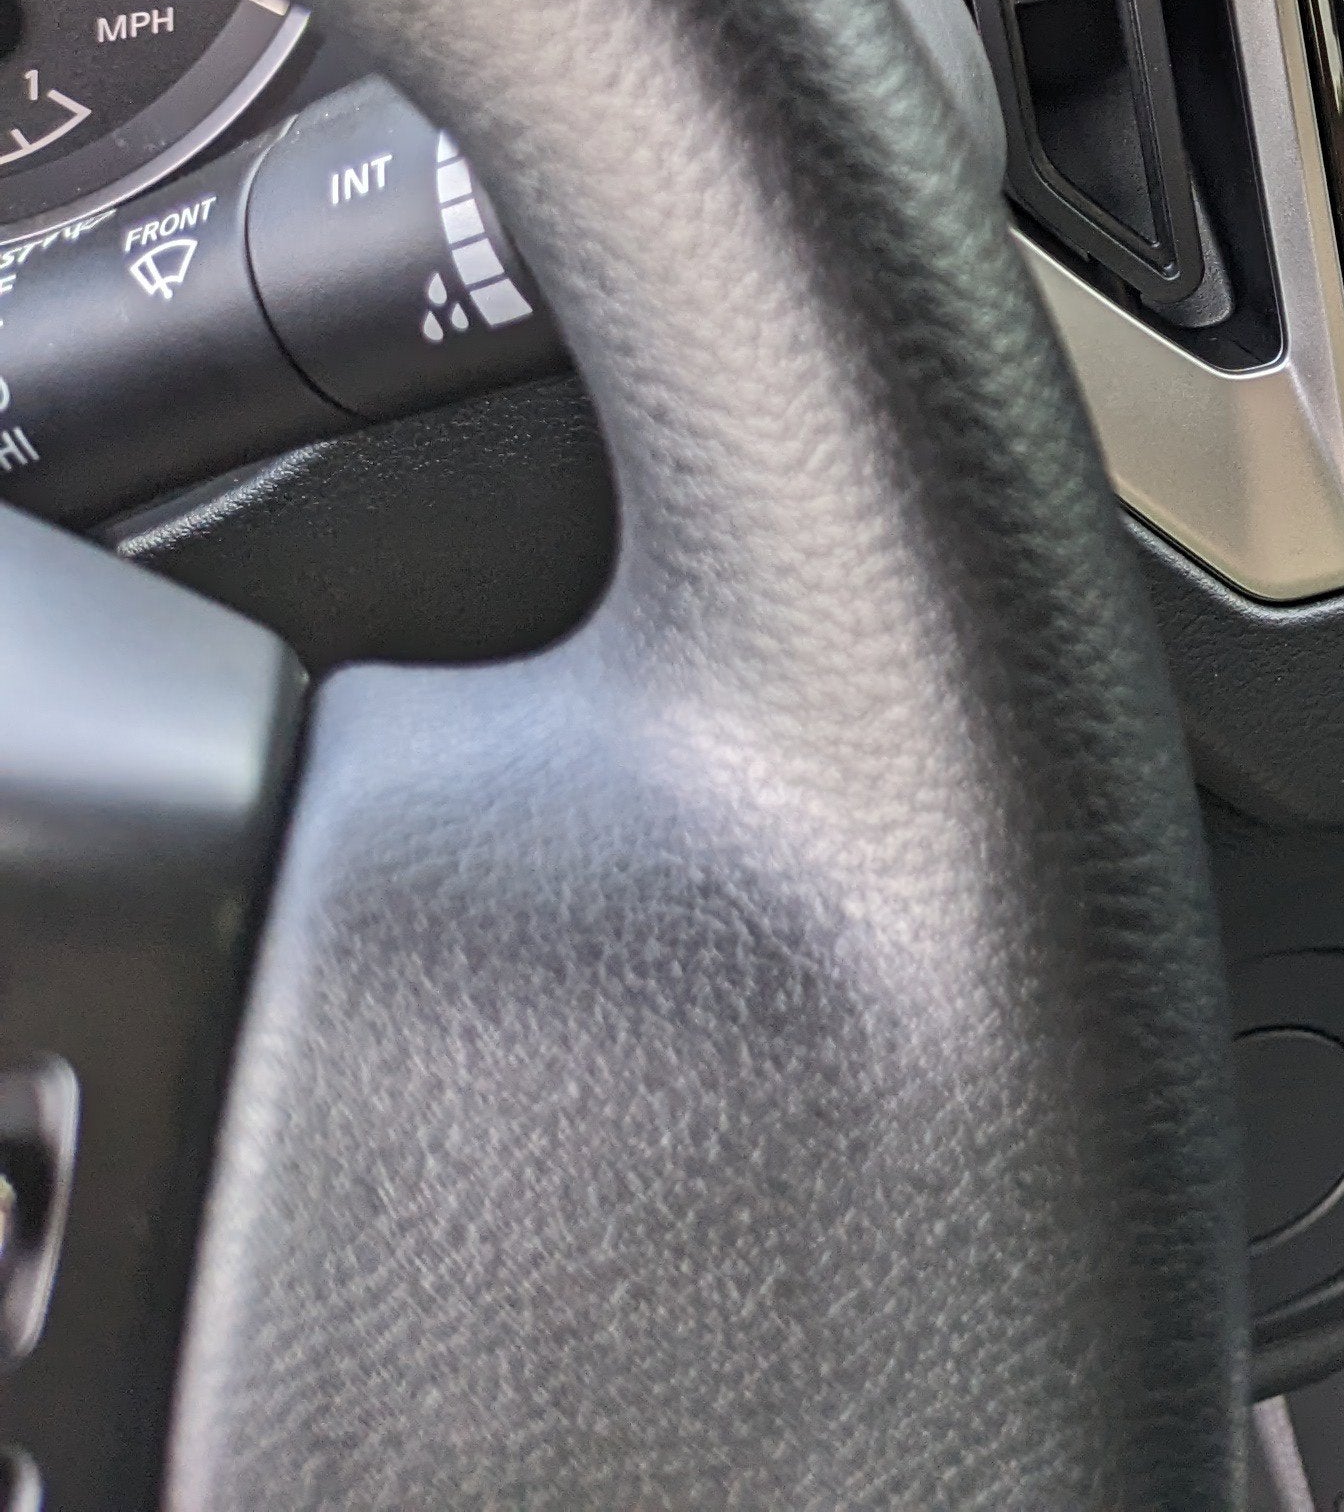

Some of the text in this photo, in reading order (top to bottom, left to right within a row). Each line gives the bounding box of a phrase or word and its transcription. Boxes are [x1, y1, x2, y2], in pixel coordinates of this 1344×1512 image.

[96, 7, 174, 43] MPH
[331, 153, 393, 205] INT
[124, 195, 217, 253] FRONT
